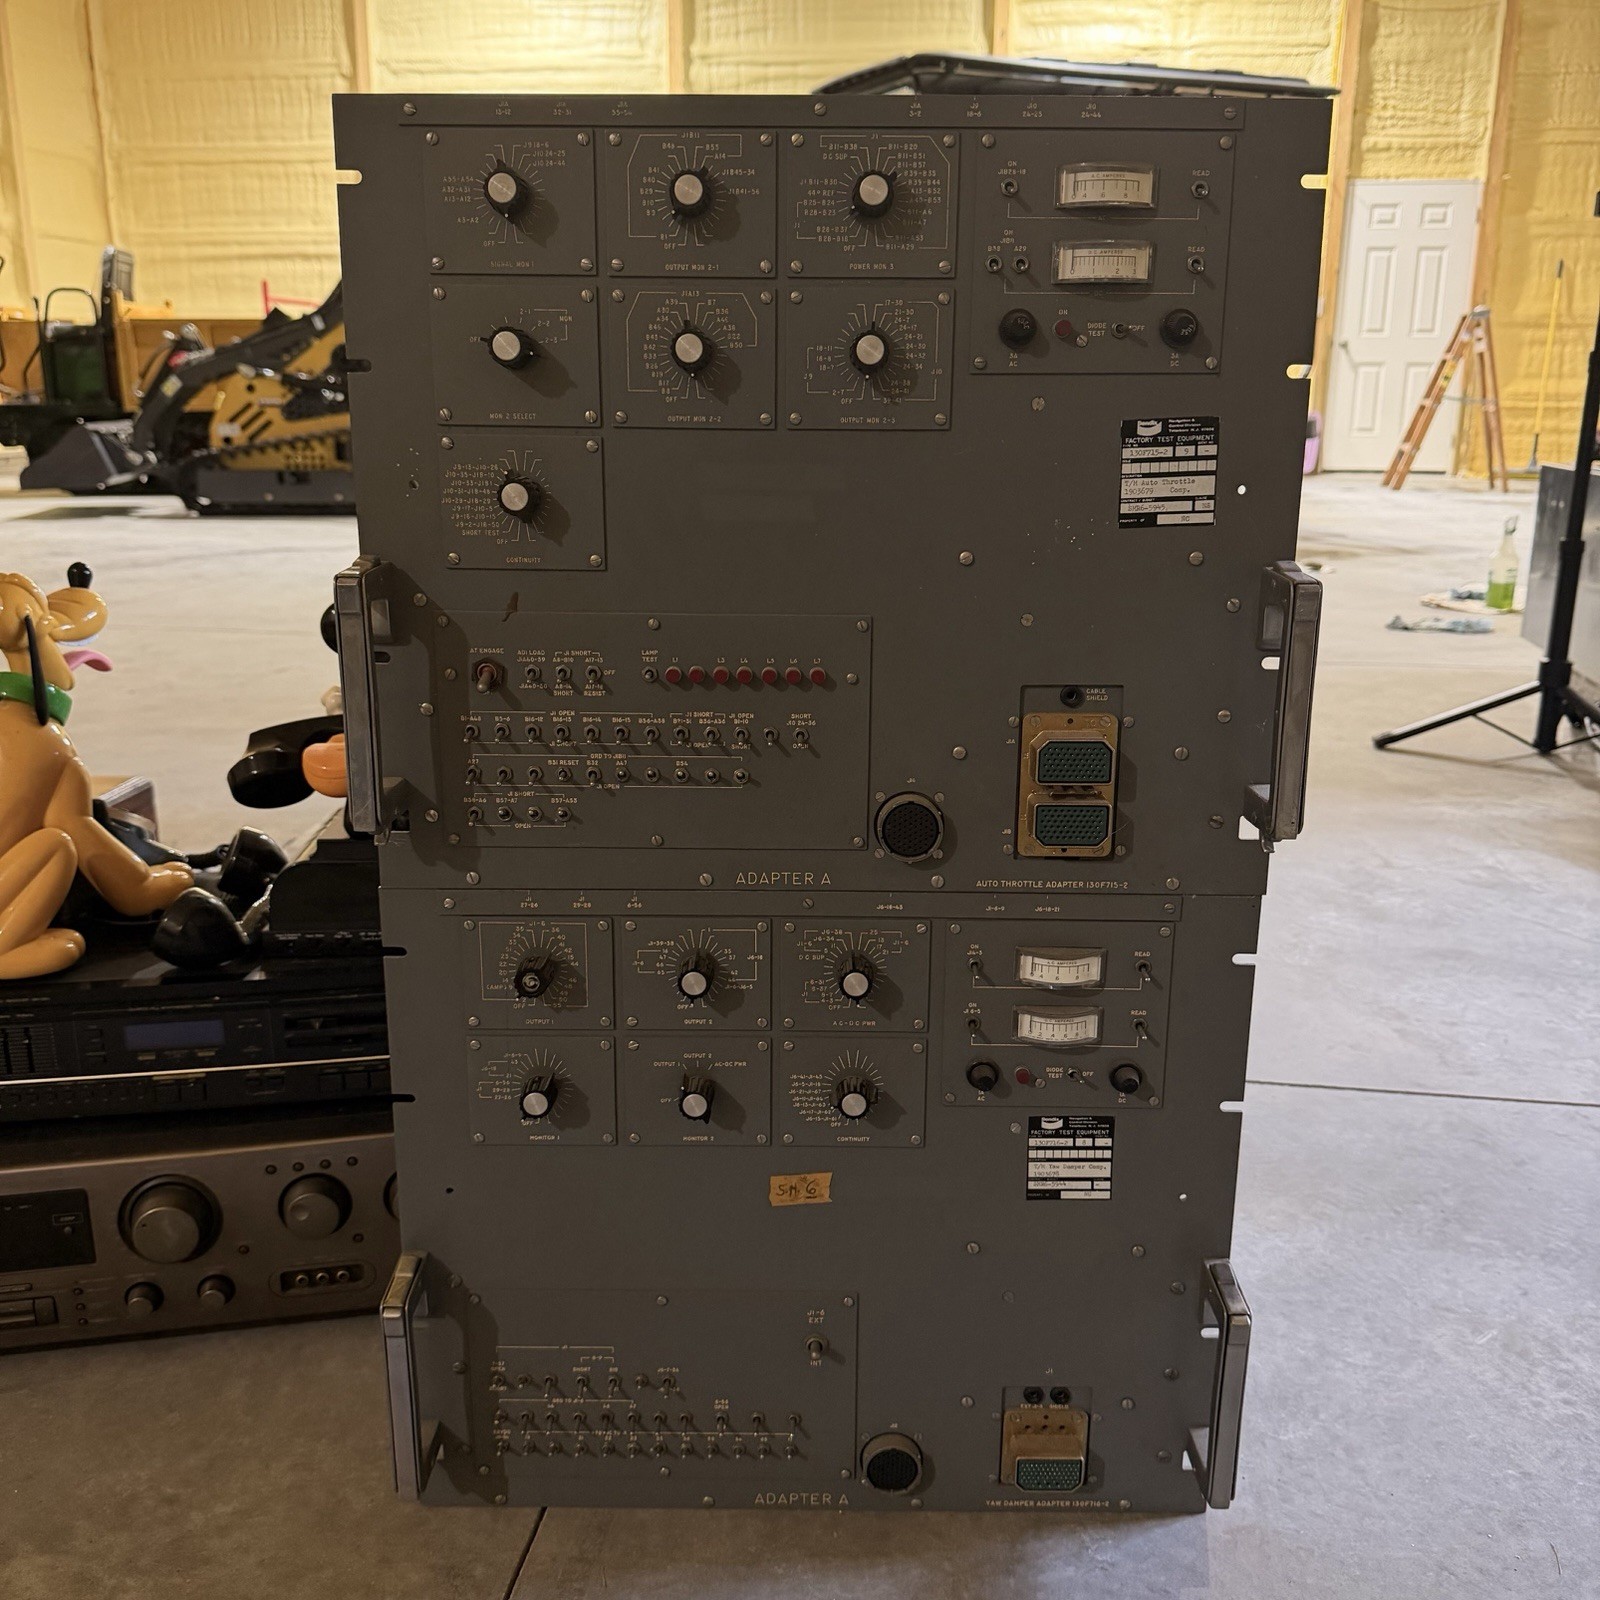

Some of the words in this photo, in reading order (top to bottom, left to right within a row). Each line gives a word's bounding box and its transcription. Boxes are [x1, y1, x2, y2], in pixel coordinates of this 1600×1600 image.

[735, 872, 813, 886] ADAPTER
[820, 873, 832, 885] A
[755, 1493, 832, 1505] ADAPTER
[838, 1493, 848, 1505] A
